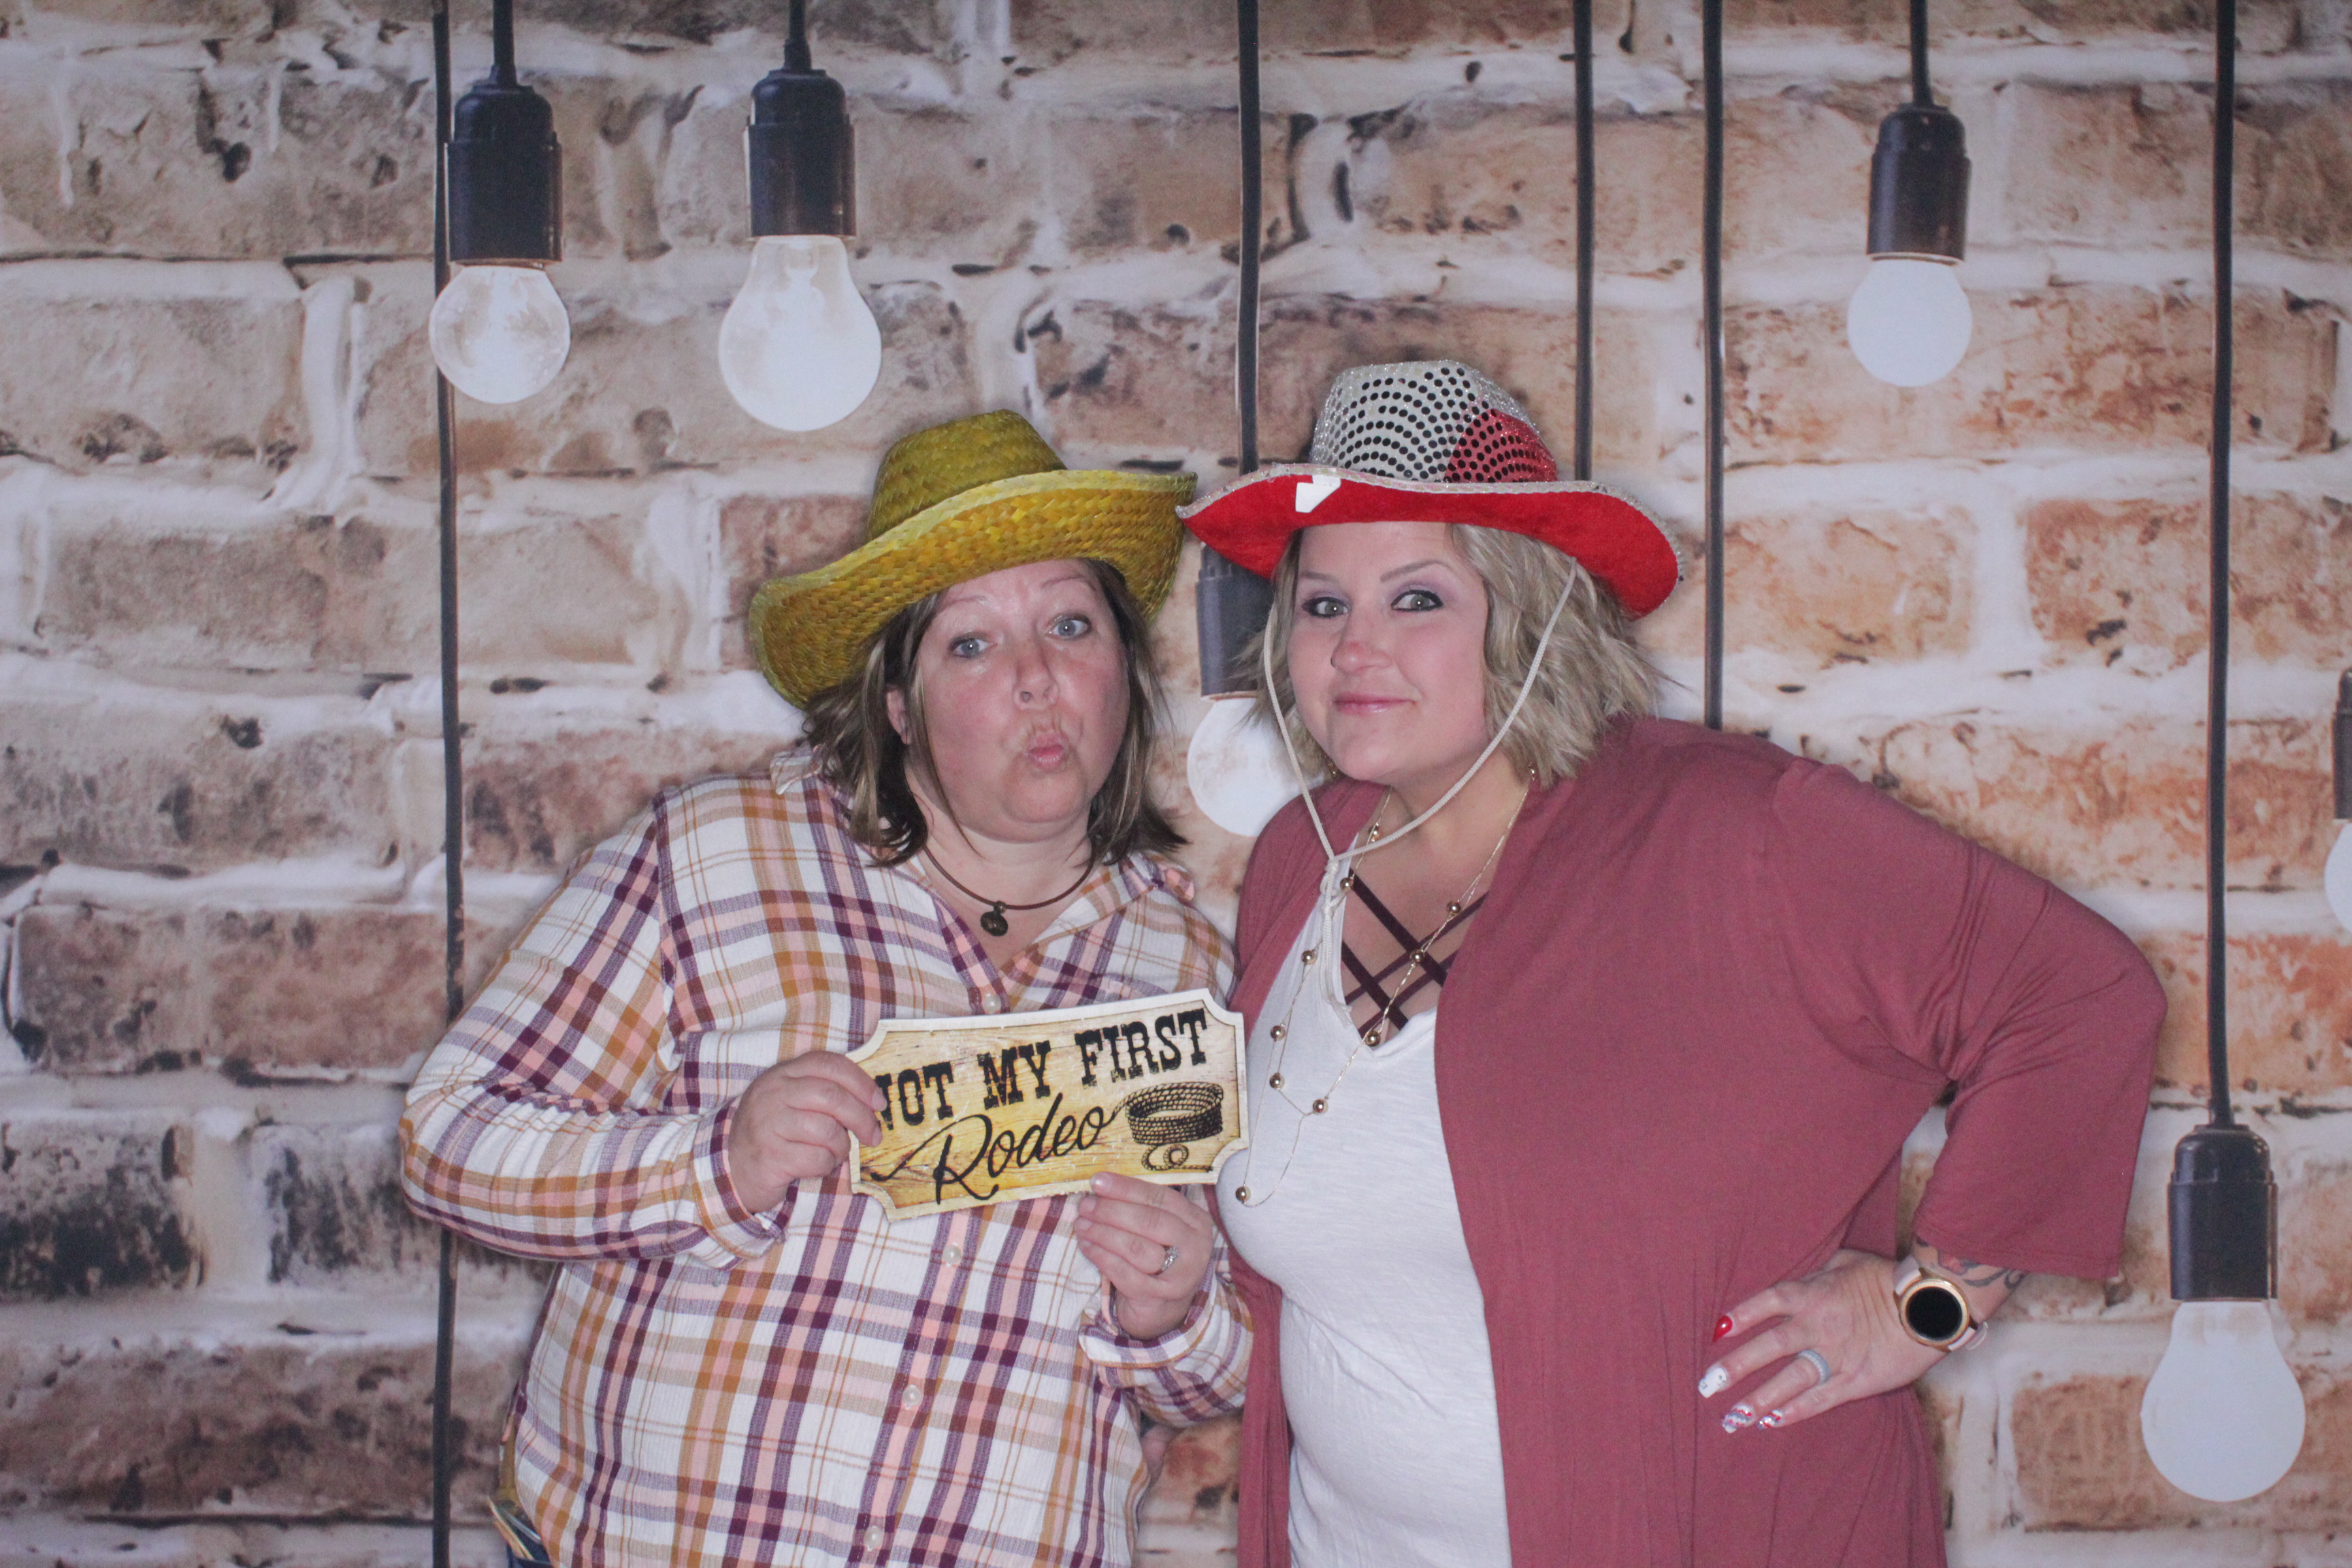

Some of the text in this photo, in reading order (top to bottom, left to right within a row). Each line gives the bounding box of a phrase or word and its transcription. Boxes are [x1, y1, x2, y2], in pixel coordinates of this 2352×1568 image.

[977, 1041, 1051, 1110] MY
[1075, 1008, 1208, 1088] FIRST
[870, 1092, 1115, 1205] Rodeo
